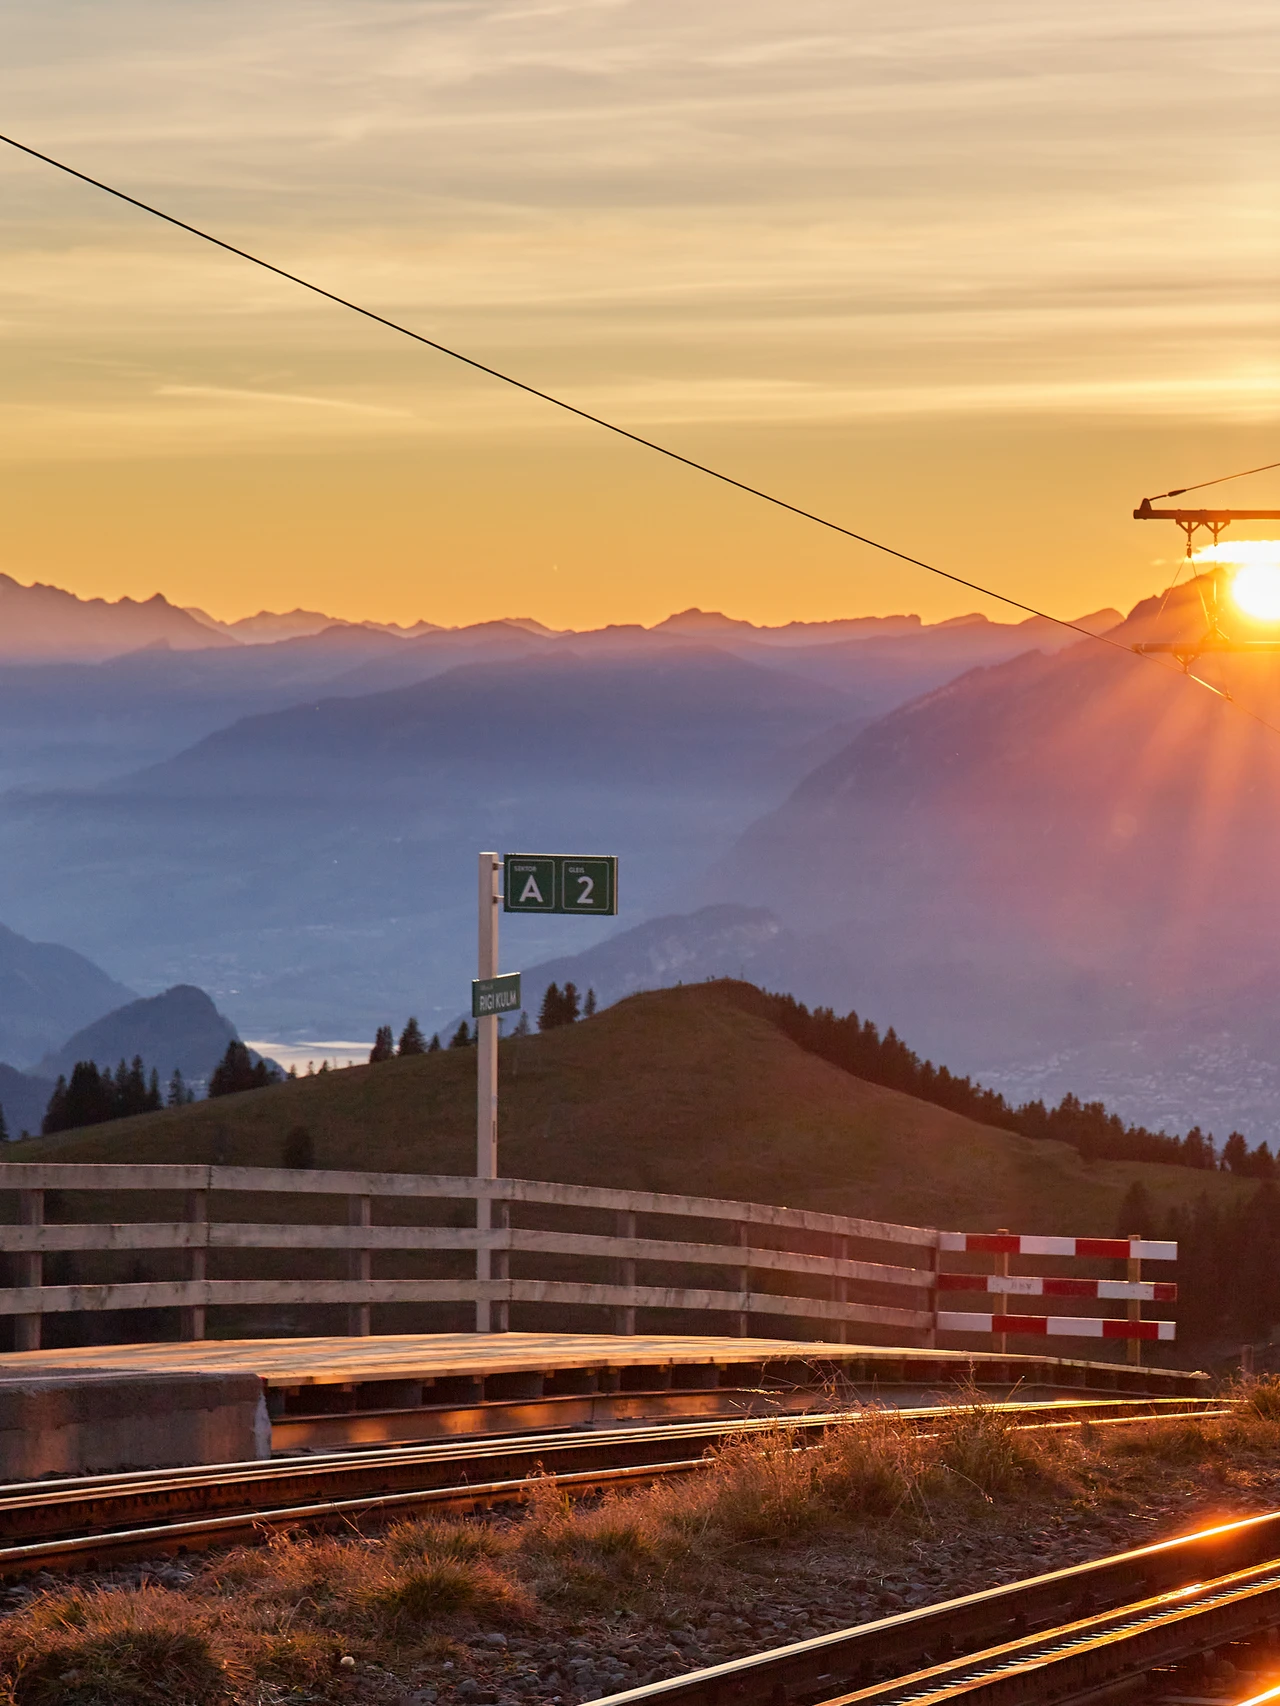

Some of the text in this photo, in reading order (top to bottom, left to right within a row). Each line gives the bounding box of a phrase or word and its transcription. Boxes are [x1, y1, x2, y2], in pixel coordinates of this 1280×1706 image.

[514, 865, 537, 873] SEKTOR
[519, 874, 544, 902] A
[577, 876, 594, 904] 2
[480, 991, 517, 1010] RIGI KULM
